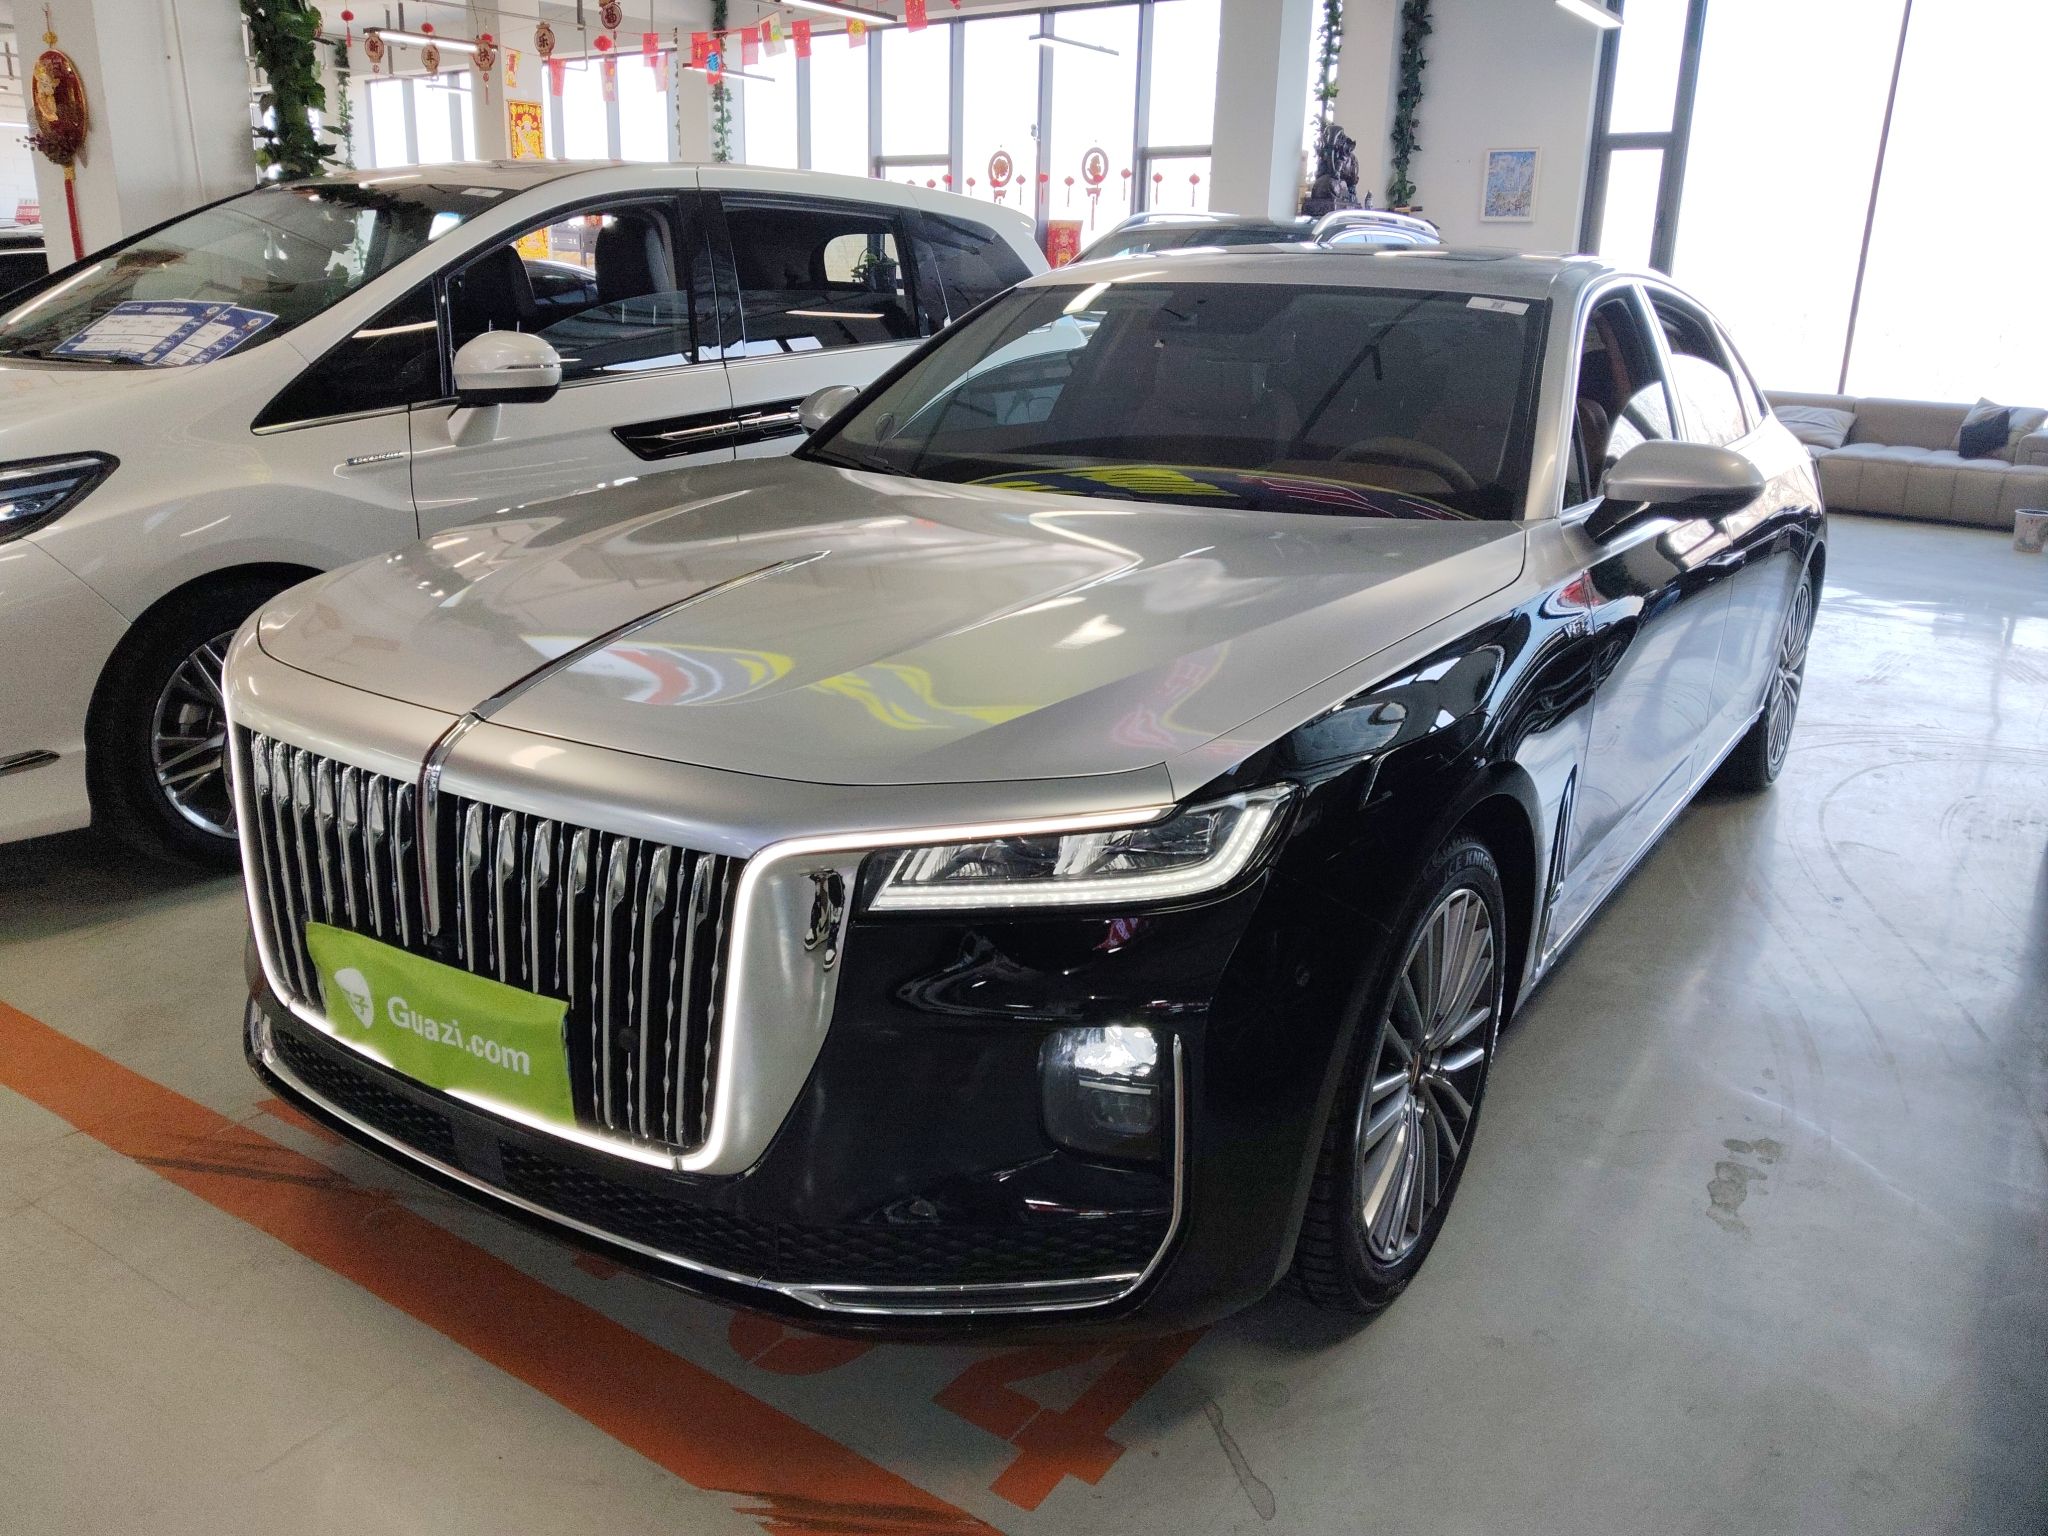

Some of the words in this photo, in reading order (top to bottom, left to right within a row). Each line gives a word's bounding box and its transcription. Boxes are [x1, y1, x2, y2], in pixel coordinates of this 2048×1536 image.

[604, 6, 618, 24] 福
[538, 33, 549, 48] 乐
[387, 996, 530, 1076] Guazi.com
